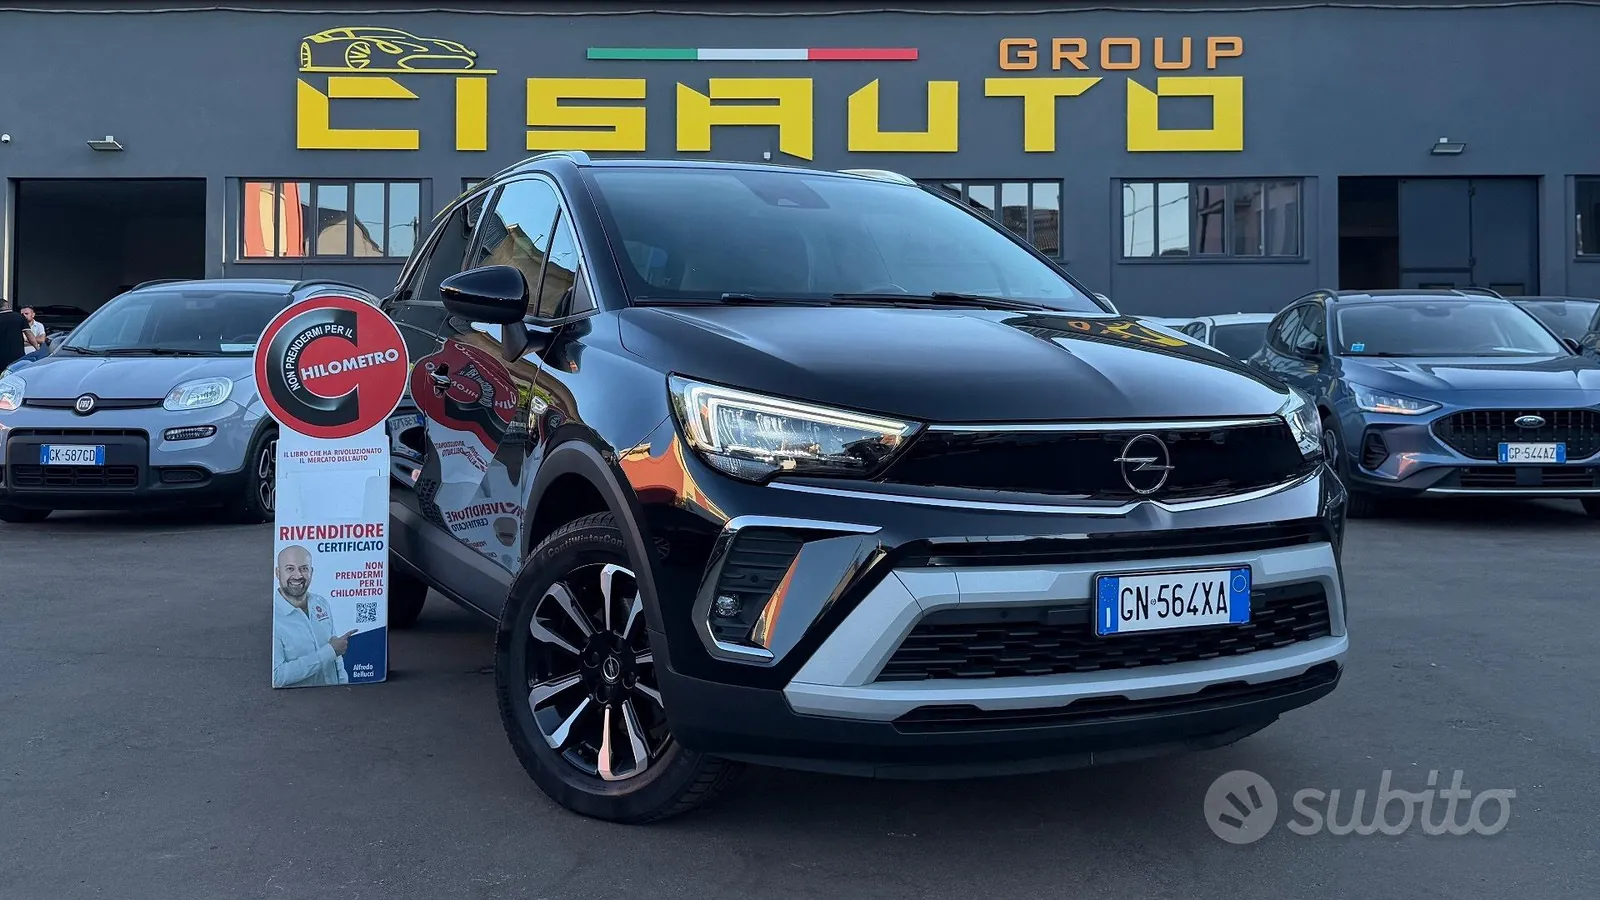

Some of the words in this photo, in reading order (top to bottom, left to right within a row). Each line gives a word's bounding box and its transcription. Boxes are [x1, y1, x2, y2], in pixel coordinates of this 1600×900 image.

[998, 36, 1244, 71] GROUP
[296, 75, 1244, 160] CISAUTO
[324, 324, 344, 334] PER
[344, 327, 354, 339] IL
[285, 326, 323, 370] PRENDERMI
[286, 371, 301, 392] NON
[290, 449, 309, 458] LIBRO
[309, 449, 322, 457] CHE
[322, 448, 332, 456] HA
[334, 447, 383, 456] RIVOLUZIONATO
[307, 456, 336, 464] MERCATO
[337, 454, 369, 463] DELL'AUTO
[279, 523, 384, 541] RIVENDITORE
[317, 540, 384, 553] CERTIFICATO
[547, 534, 626, 557] ContiWinterCon
[365, 561, 384, 570] NON
[335, 571, 384, 580] PRENDERMI
[359, 579, 375, 588] PER
[376, 579, 384, 587] IL
[330, 587, 384, 598] CHILOMETRO
[353, 663, 374, 671] Alfredo
[353, 670, 375, 678] Bellucci
